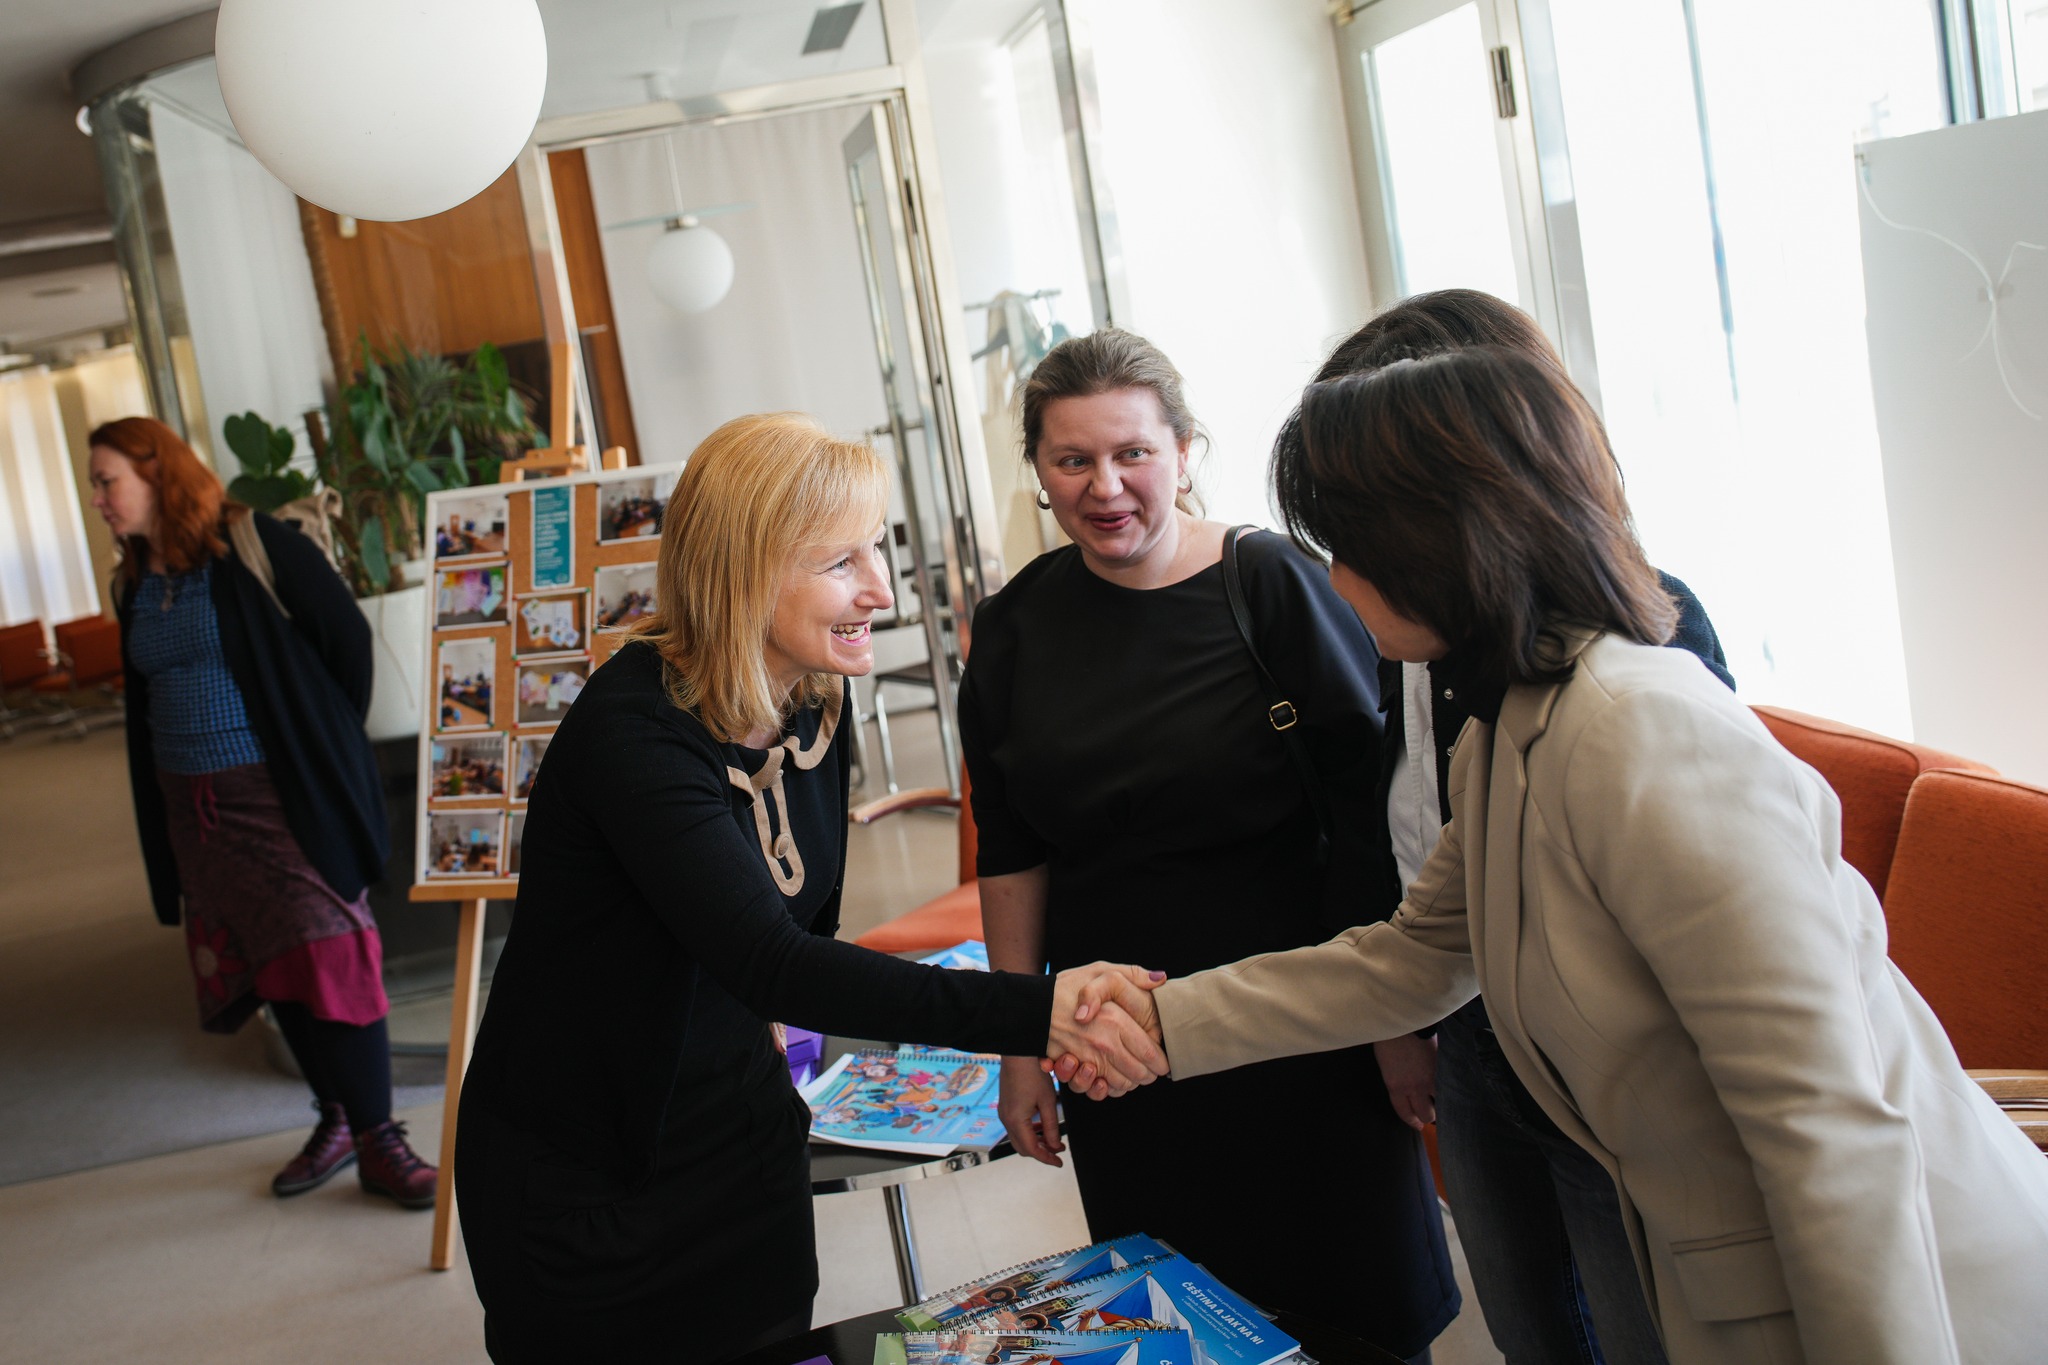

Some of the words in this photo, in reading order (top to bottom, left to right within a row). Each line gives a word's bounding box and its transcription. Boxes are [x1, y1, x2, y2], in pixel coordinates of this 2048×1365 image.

[1182, 1281, 1217, 1310] ČEŠTINA
[1221, 1314, 1242, 1328] JAK
[1237, 1326, 1253, 1338] NA
[1249, 1335, 1265, 1345] NI
